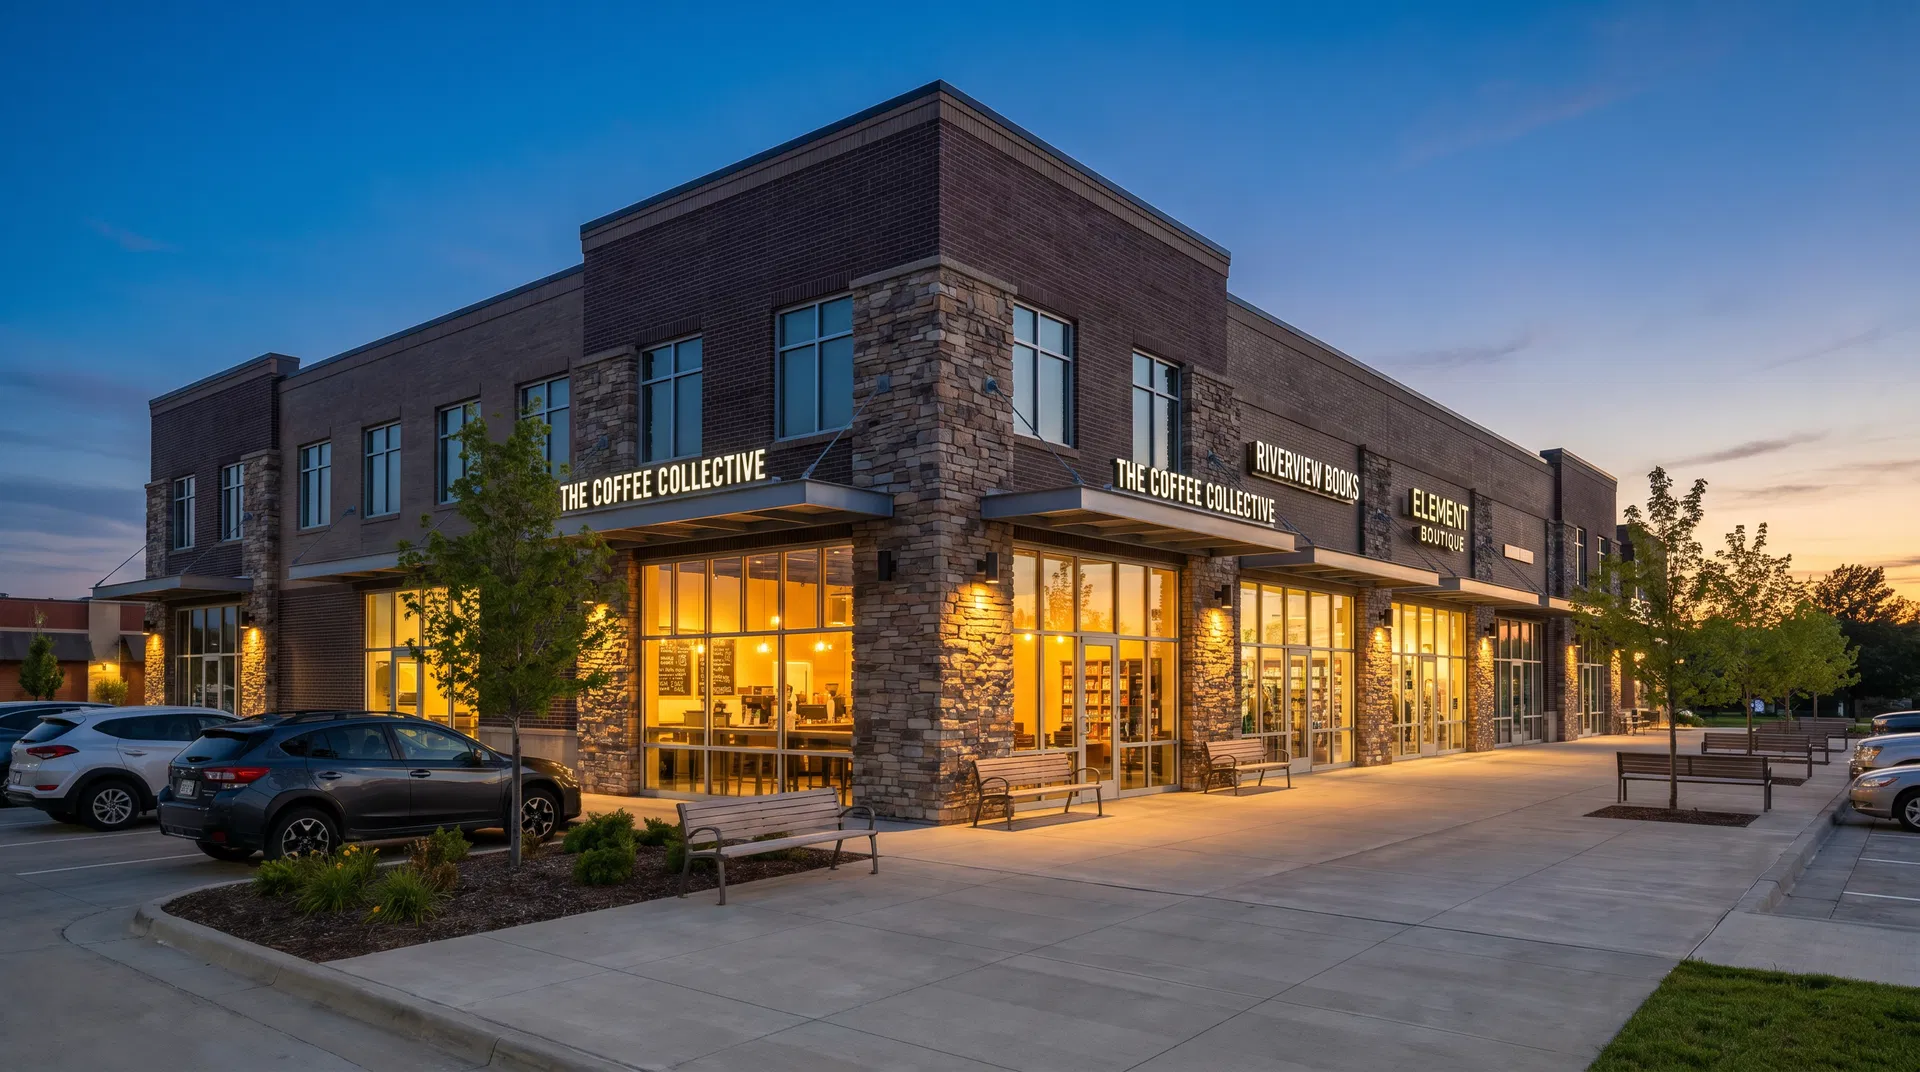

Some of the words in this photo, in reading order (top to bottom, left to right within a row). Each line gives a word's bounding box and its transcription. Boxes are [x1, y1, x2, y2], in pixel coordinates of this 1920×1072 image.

[560, 481, 588, 511] THE
[592, 470, 652, 506] COFFEE
[658, 449, 766, 496] COLLECTIVE
[1116, 458, 1146, 493] THE
[1150, 468, 1202, 506] COFFEE
[1206, 482, 1275, 523] COLLECTIVE
[1256, 440, 1322, 489] RIVERVIEW
[1325, 464, 1359, 501] BOOKS
[1413, 488, 1469, 531] ELEMENT
[1421, 525, 1464, 552] BOUTIQUE
